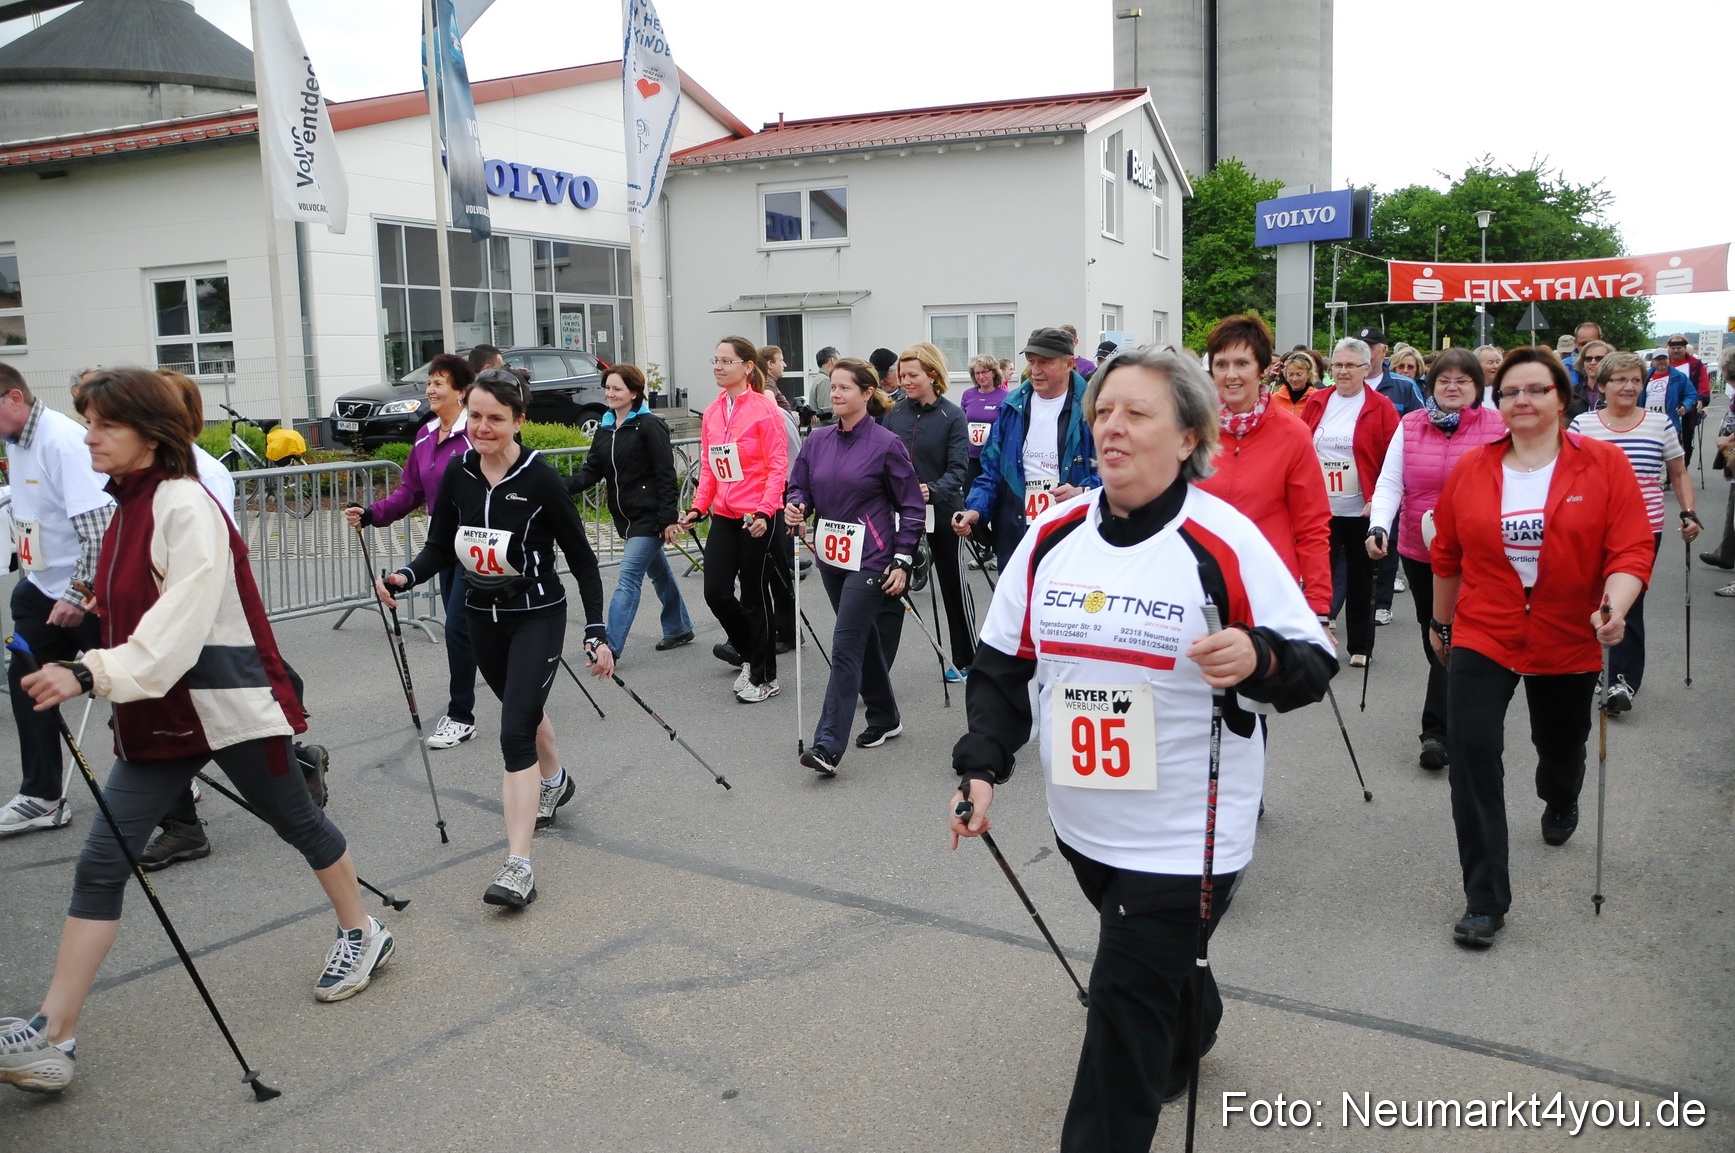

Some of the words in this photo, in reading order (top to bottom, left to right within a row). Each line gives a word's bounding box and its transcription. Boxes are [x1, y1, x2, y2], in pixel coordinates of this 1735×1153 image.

[301, 56, 320, 145] entdec
[441, 150, 598, 209] OLVO
[1263, 205, 1336, 230] VOLVO
[972, 429, 984, 443] 37
[1026, 450, 1044, 459] Sport
[716, 457, 732, 479] 61
[1328, 471, 1343, 492] 11
[1025, 493, 1050, 520] 42
[825, 521, 845, 529] MEYER
[464, 529, 488, 539] MEYER
[825, 534, 851, 563] 93
[470, 546, 504, 574] 24
[1039, 619, 1079, 630] Regensburger
[1080, 622, 1092, 630] Str.
[1047, 629, 1088, 638] 09181/254801
[1120, 627, 1142, 637] 92318
[1144, 631, 1179, 643] Neumarkt
[1113, 635, 1127, 643] Fax
[1129, 637, 1178, 652] 09181/254803
[1065, 688, 1108, 702] MEYER
[1064, 701, 1109, 711] WERBUNG
[1071, 715, 1131, 778] 95
